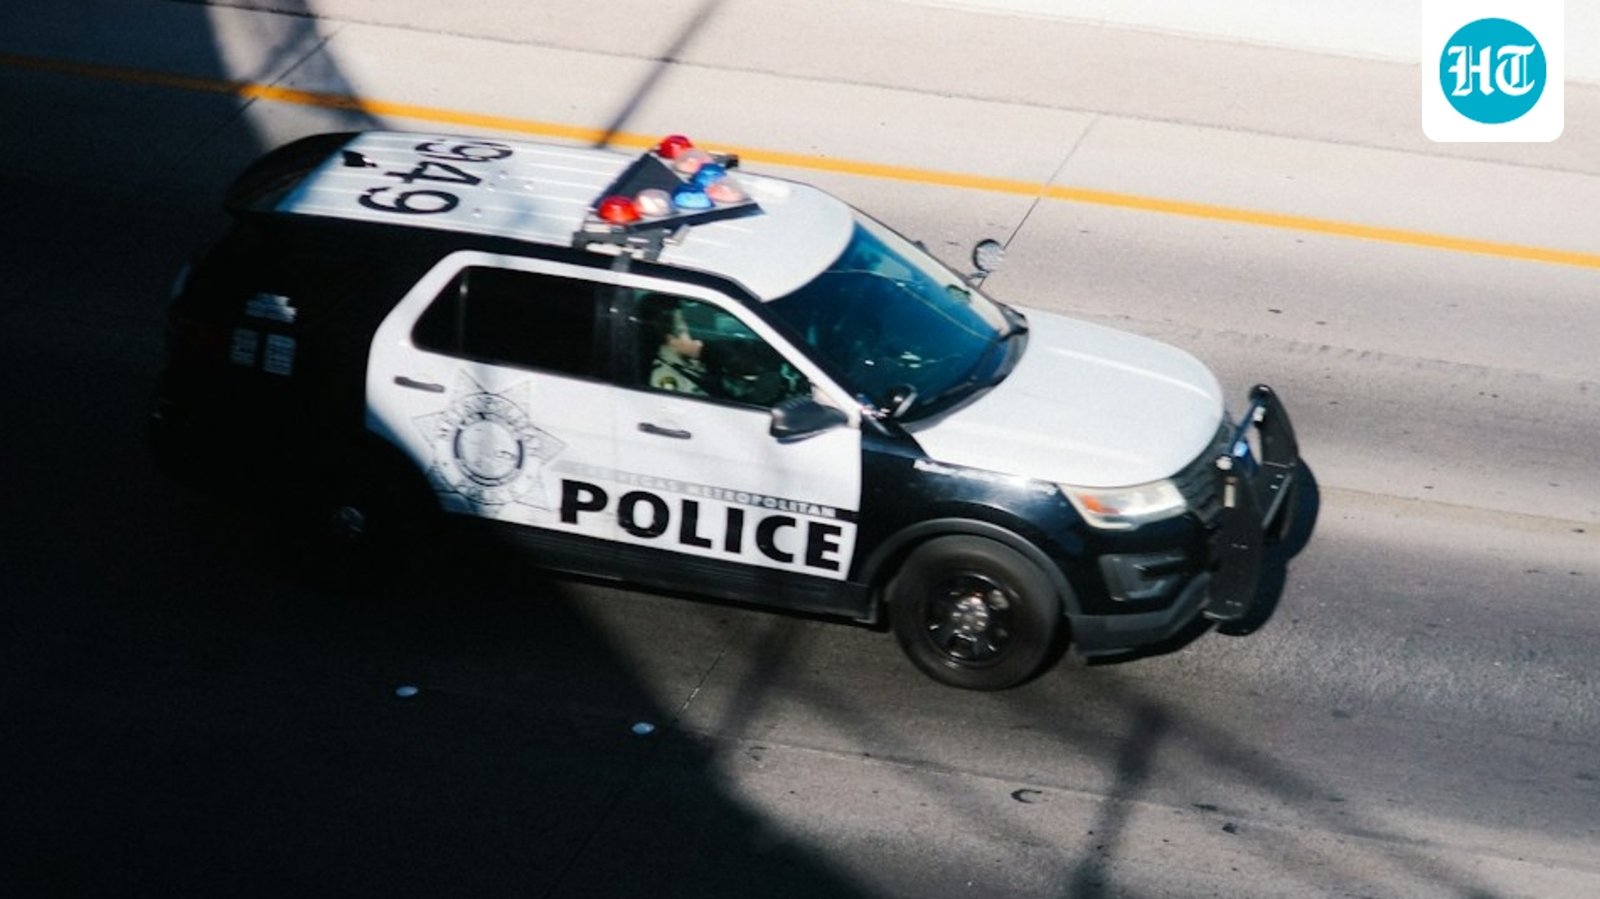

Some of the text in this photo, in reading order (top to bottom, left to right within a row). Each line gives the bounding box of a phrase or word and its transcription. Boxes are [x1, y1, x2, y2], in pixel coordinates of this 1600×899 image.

[358, 140, 513, 214] 949
[560, 478, 843, 571] POLICE
[685, 481, 836, 518] METROPOLITAN
